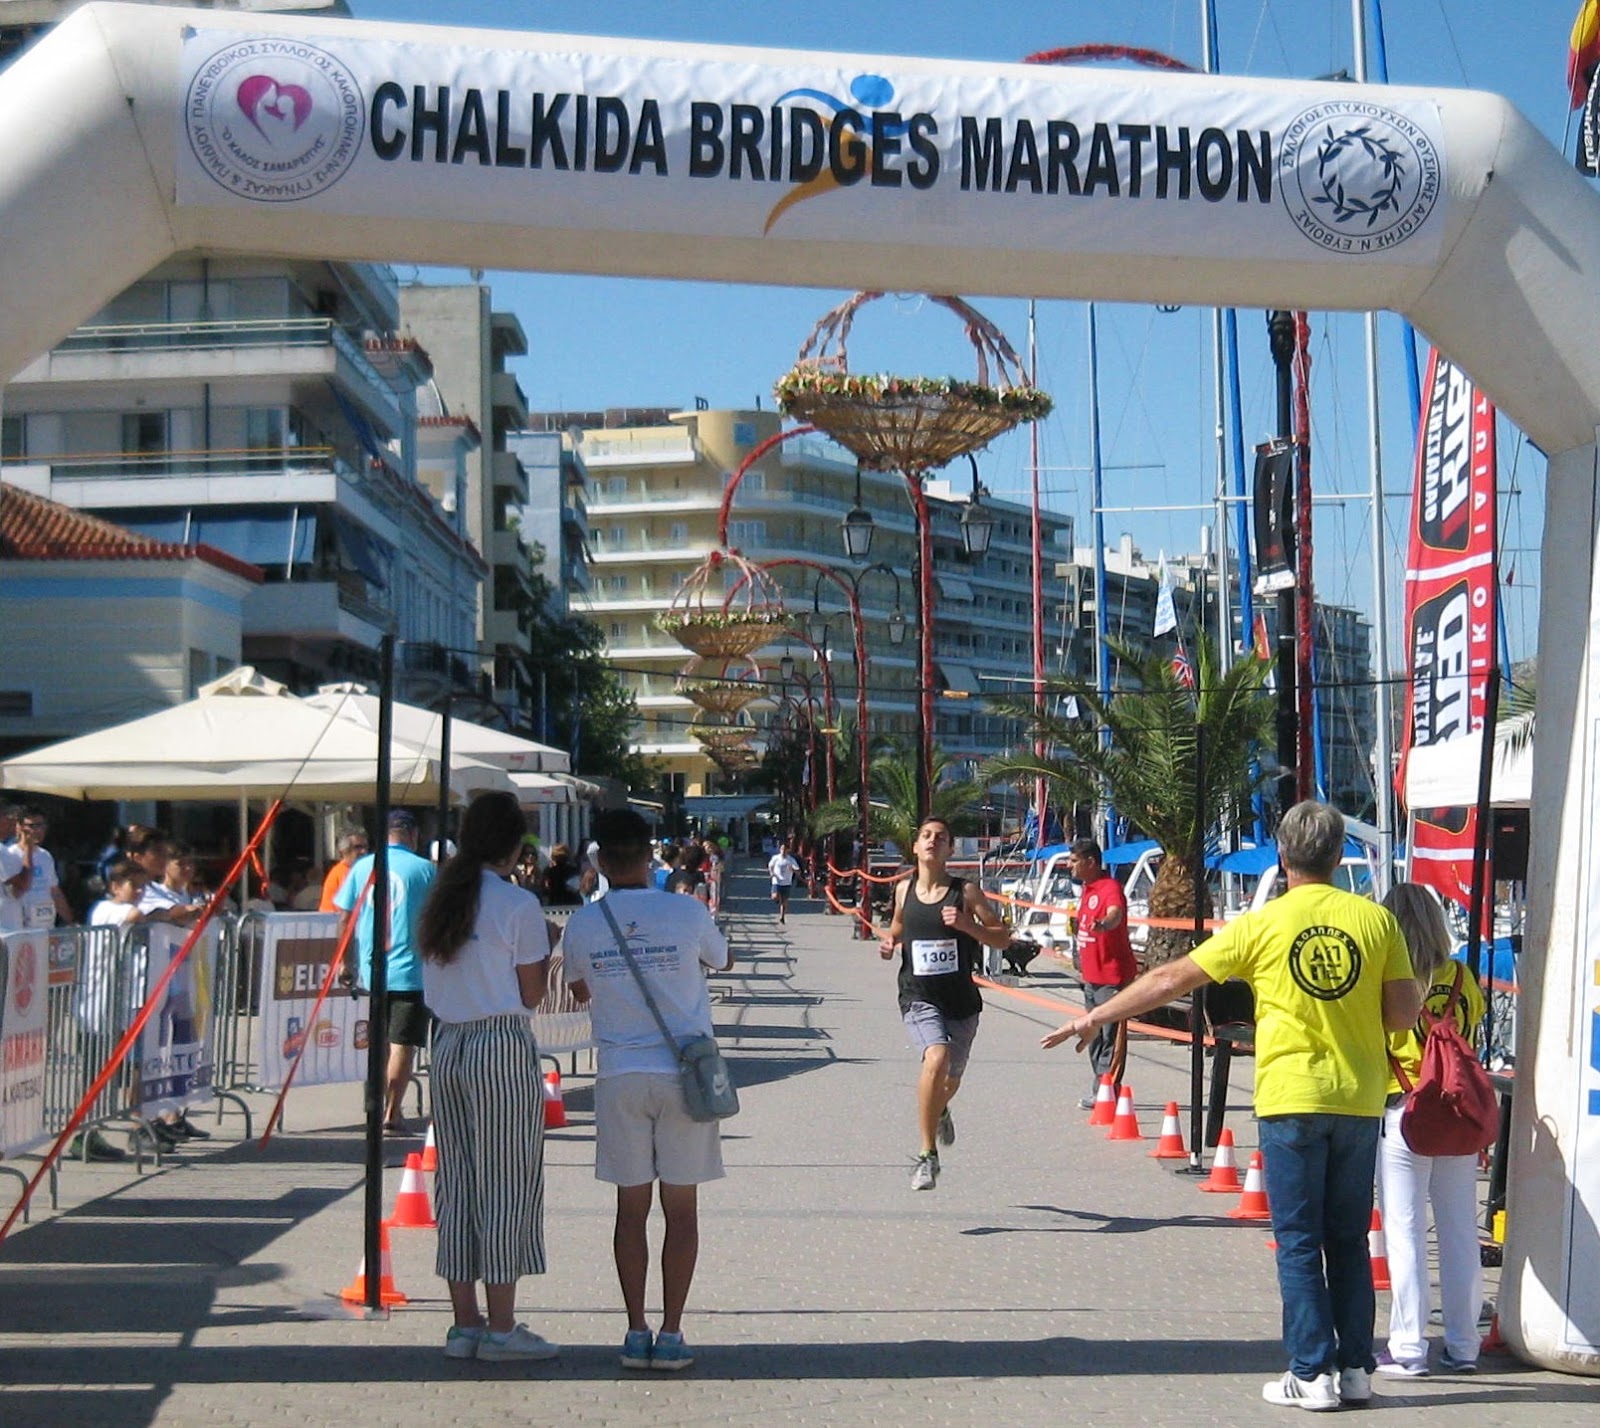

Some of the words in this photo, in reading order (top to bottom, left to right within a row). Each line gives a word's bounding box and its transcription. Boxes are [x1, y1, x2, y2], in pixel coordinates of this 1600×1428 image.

[261, 42, 333, 71] ΣΥΛΛΟΓΟΣ
[1283, 109, 1324, 168] ΣΥΛΛΟΓΟΣ
[1324, 103, 1418, 137] ΠΤΥΧΙΟΥΧΩΝ
[369, 81, 669, 177] CHALKIDA
[689, 101, 940, 190] BRIDGES
[960, 116, 1273, 204] MARATHON
[1415, 137, 1438, 202] ΦΥΣΙΚΗΣ
[1295, 209, 1352, 250] ΕΥΒΟΙΑΣ
[1376, 203, 1426, 249] ΑΓΩΓΗΣ
[922, 950, 956, 963] 1305
